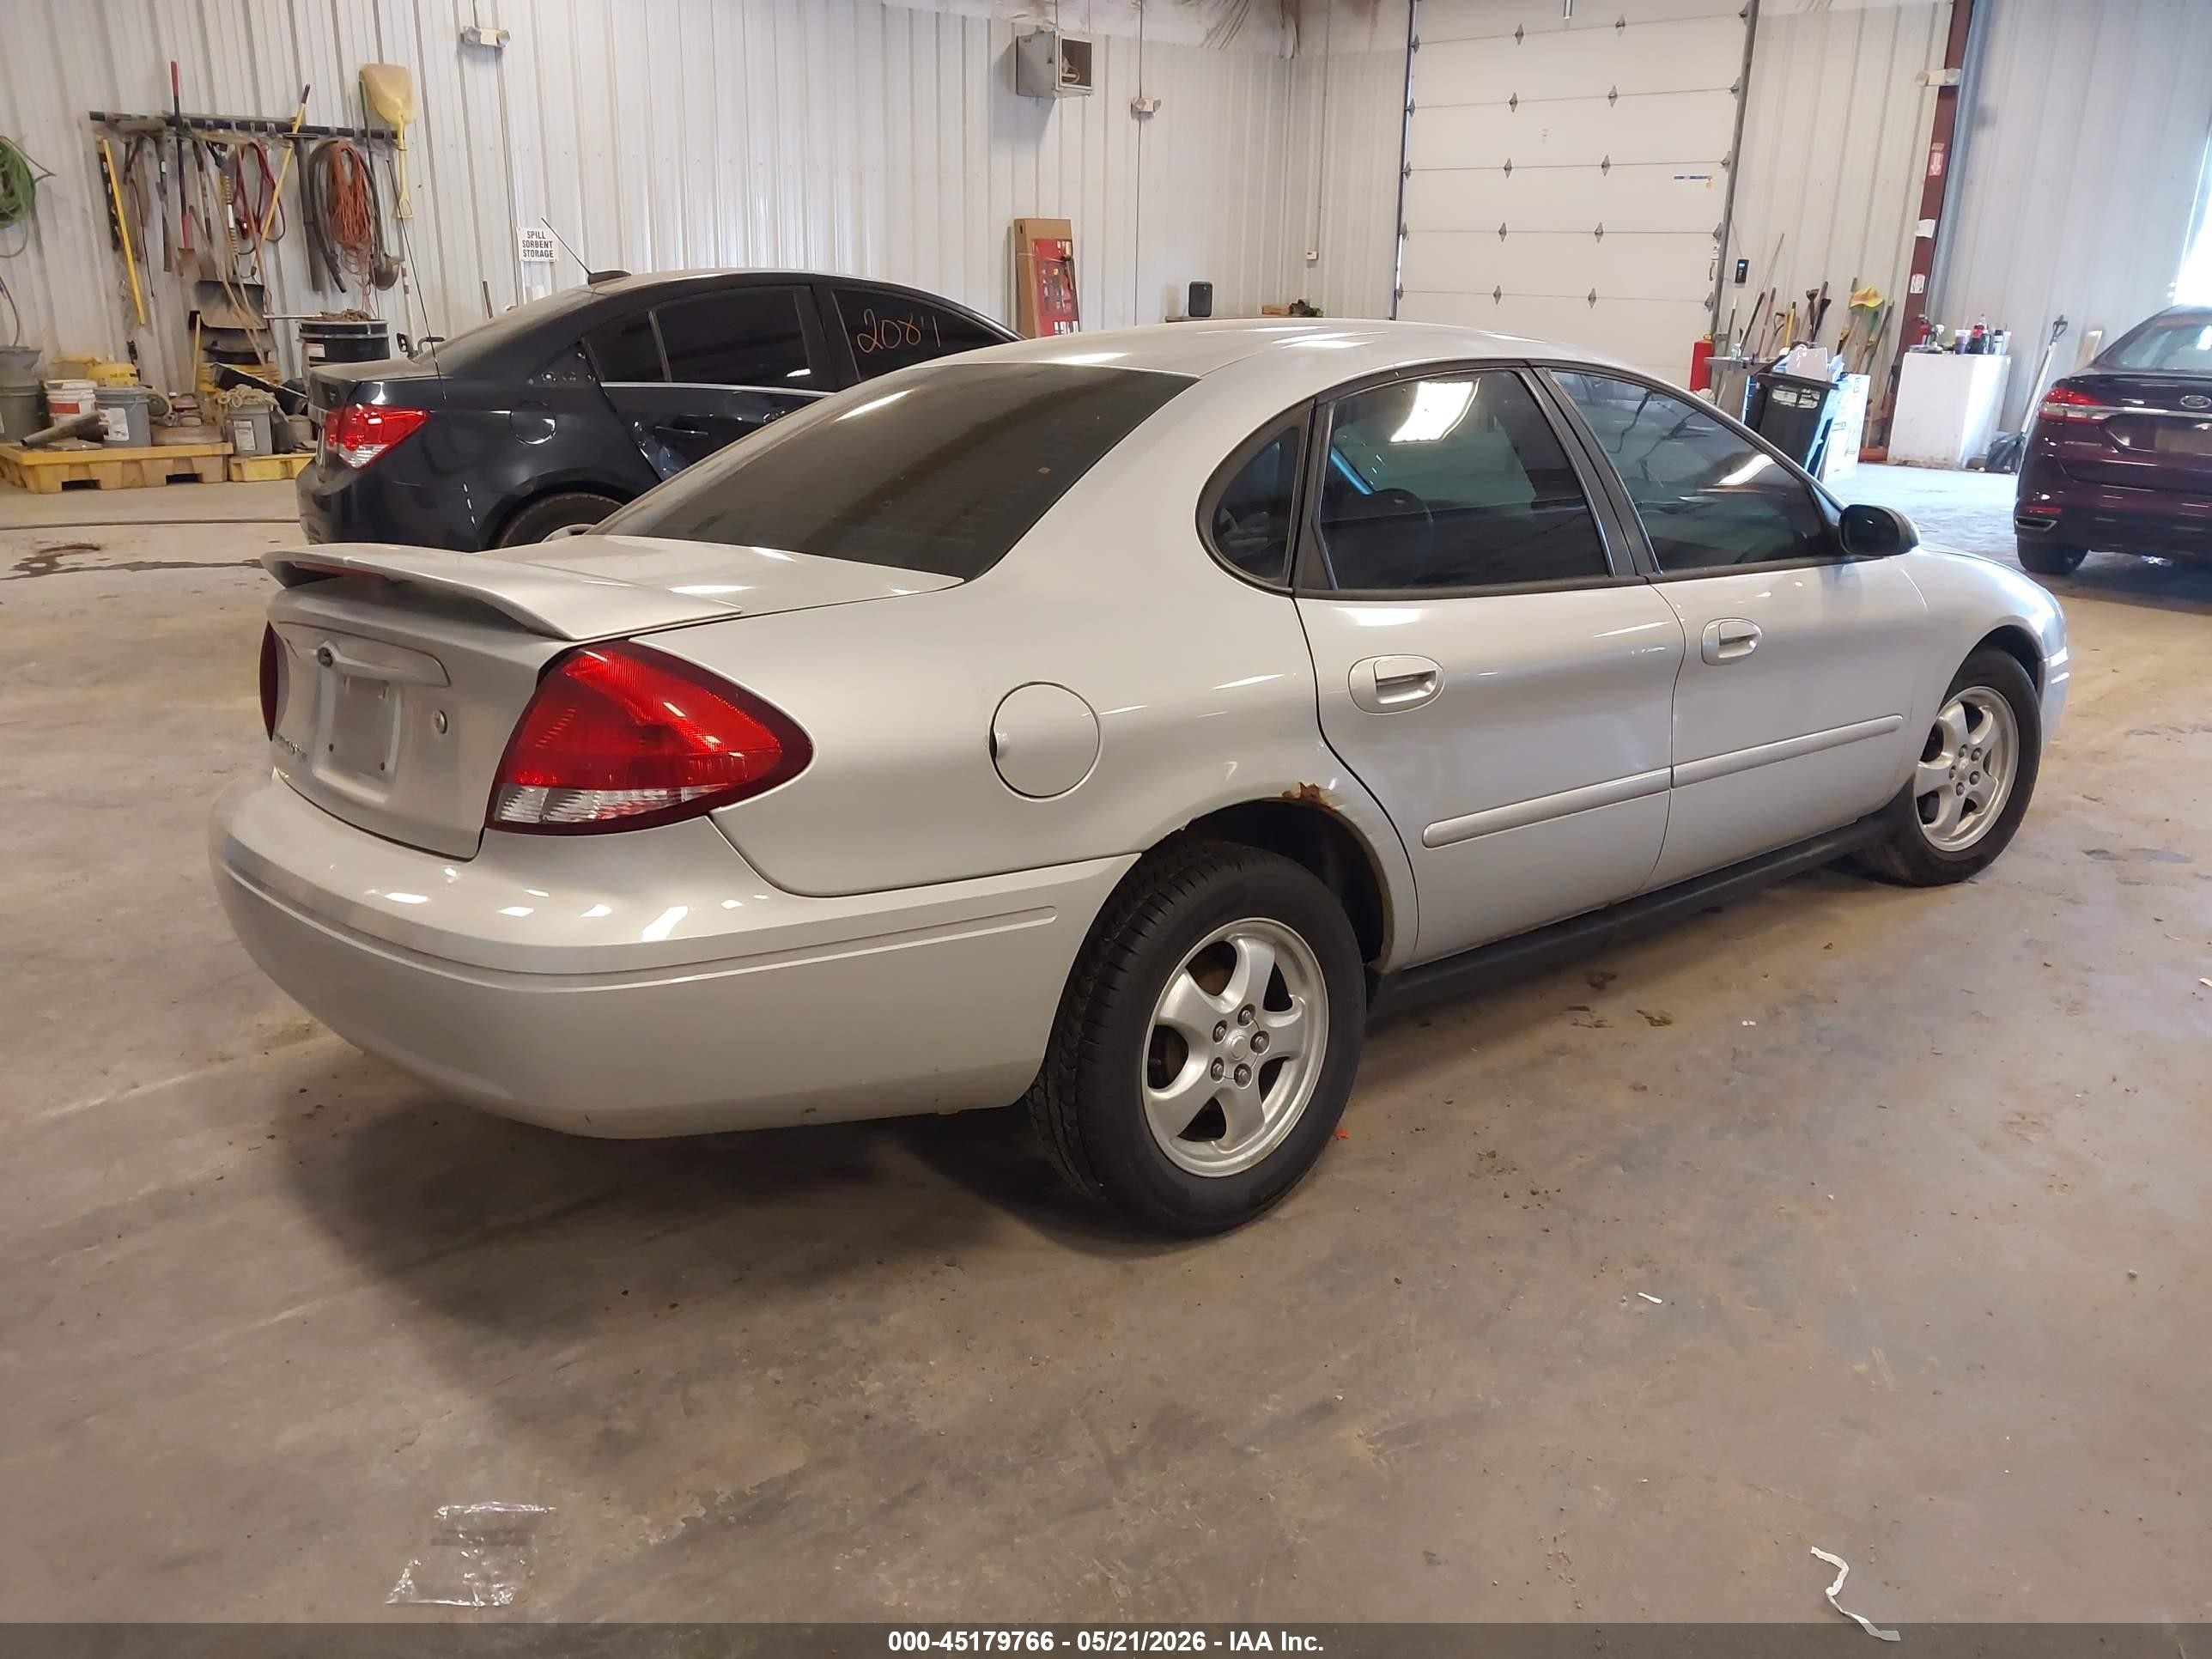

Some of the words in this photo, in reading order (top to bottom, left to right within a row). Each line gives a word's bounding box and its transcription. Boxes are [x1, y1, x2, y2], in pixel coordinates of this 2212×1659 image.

[526, 230, 546, 240] SPILL
[522, 240, 554, 249] SORBENT
[522, 249, 554, 258] STORAGE
